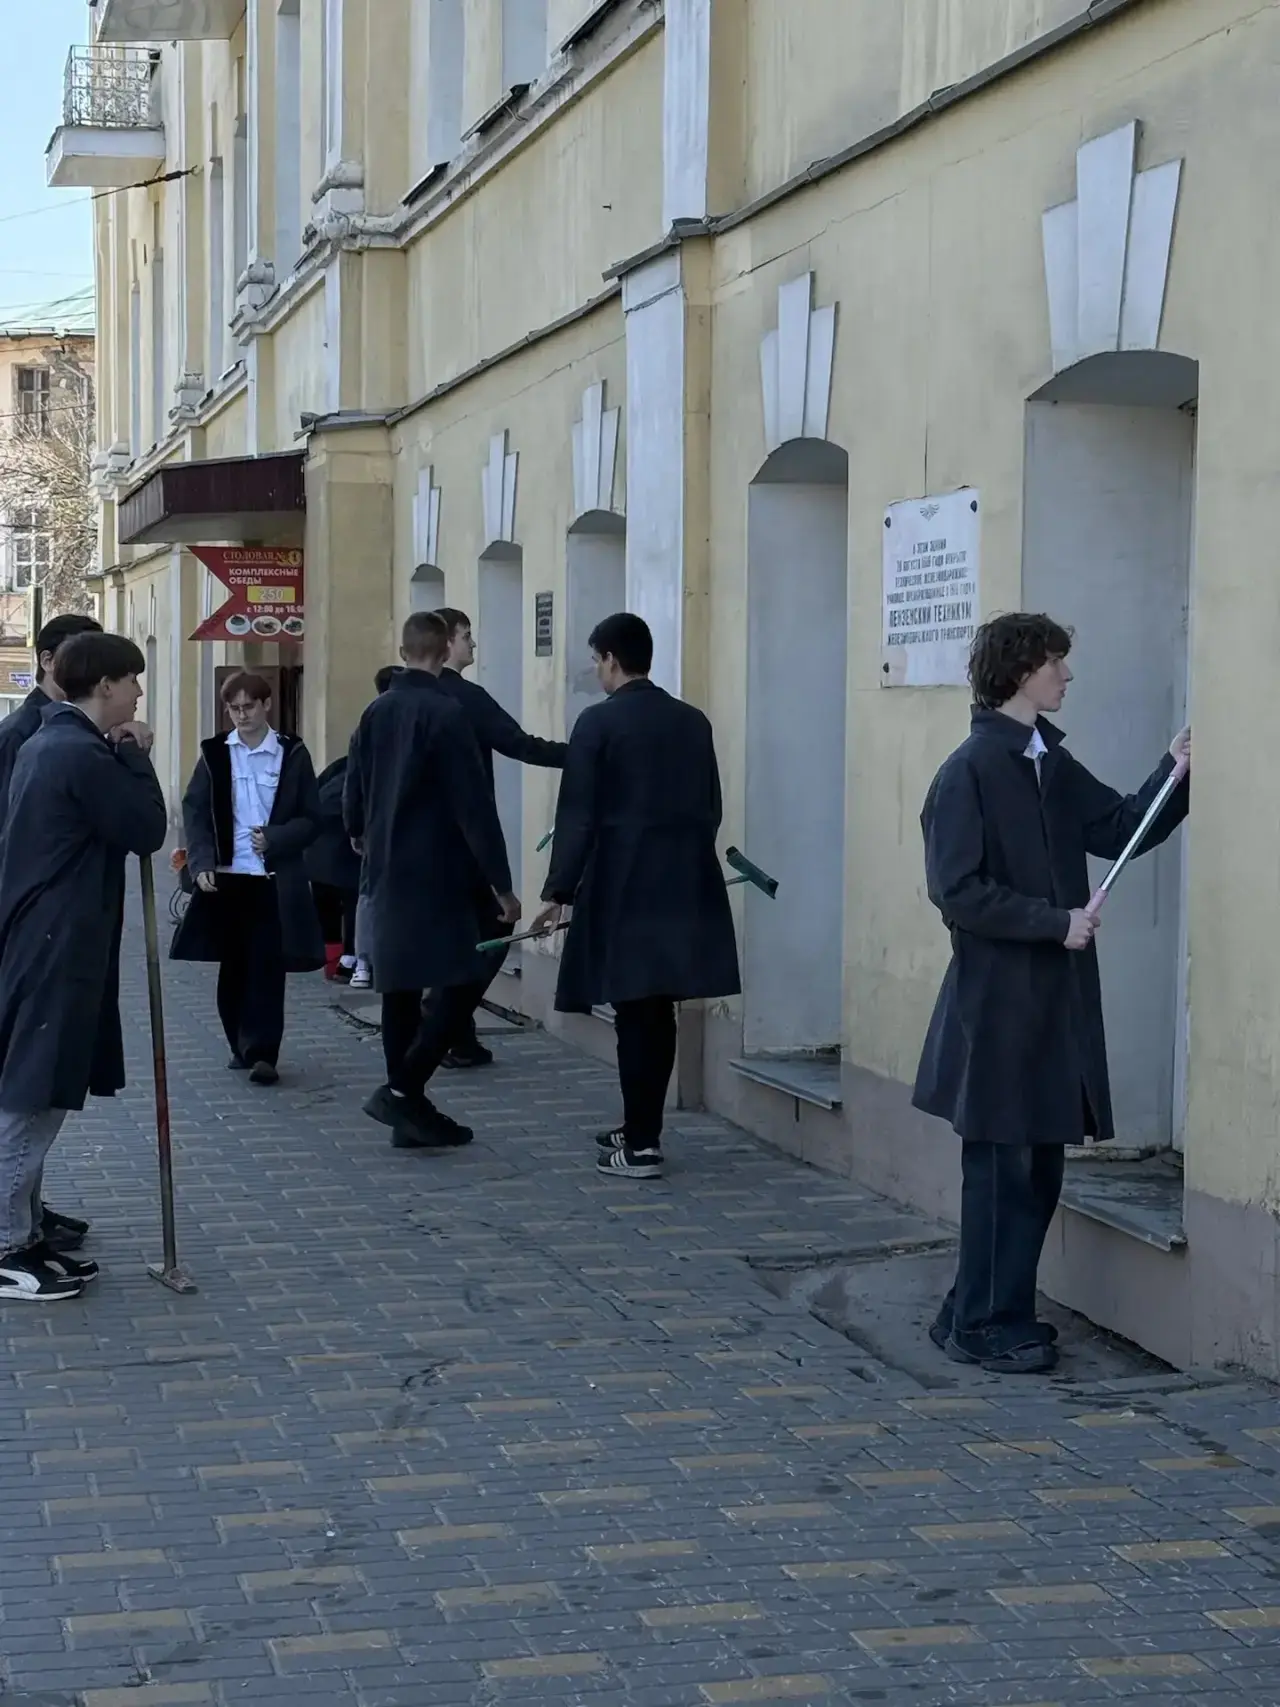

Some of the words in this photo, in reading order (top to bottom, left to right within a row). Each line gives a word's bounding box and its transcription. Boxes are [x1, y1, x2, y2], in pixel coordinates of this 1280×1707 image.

[229, 568, 298, 577] КОМПЛЕКСНЫЕ
[229, 576, 262, 585] ОБЕДЫ
[259, 588, 284, 601] 250
[889, 606, 932, 628] ПЕНЗЕНСКИЙ
[934, 600, 972, 623] ТЕХНИКУМ
